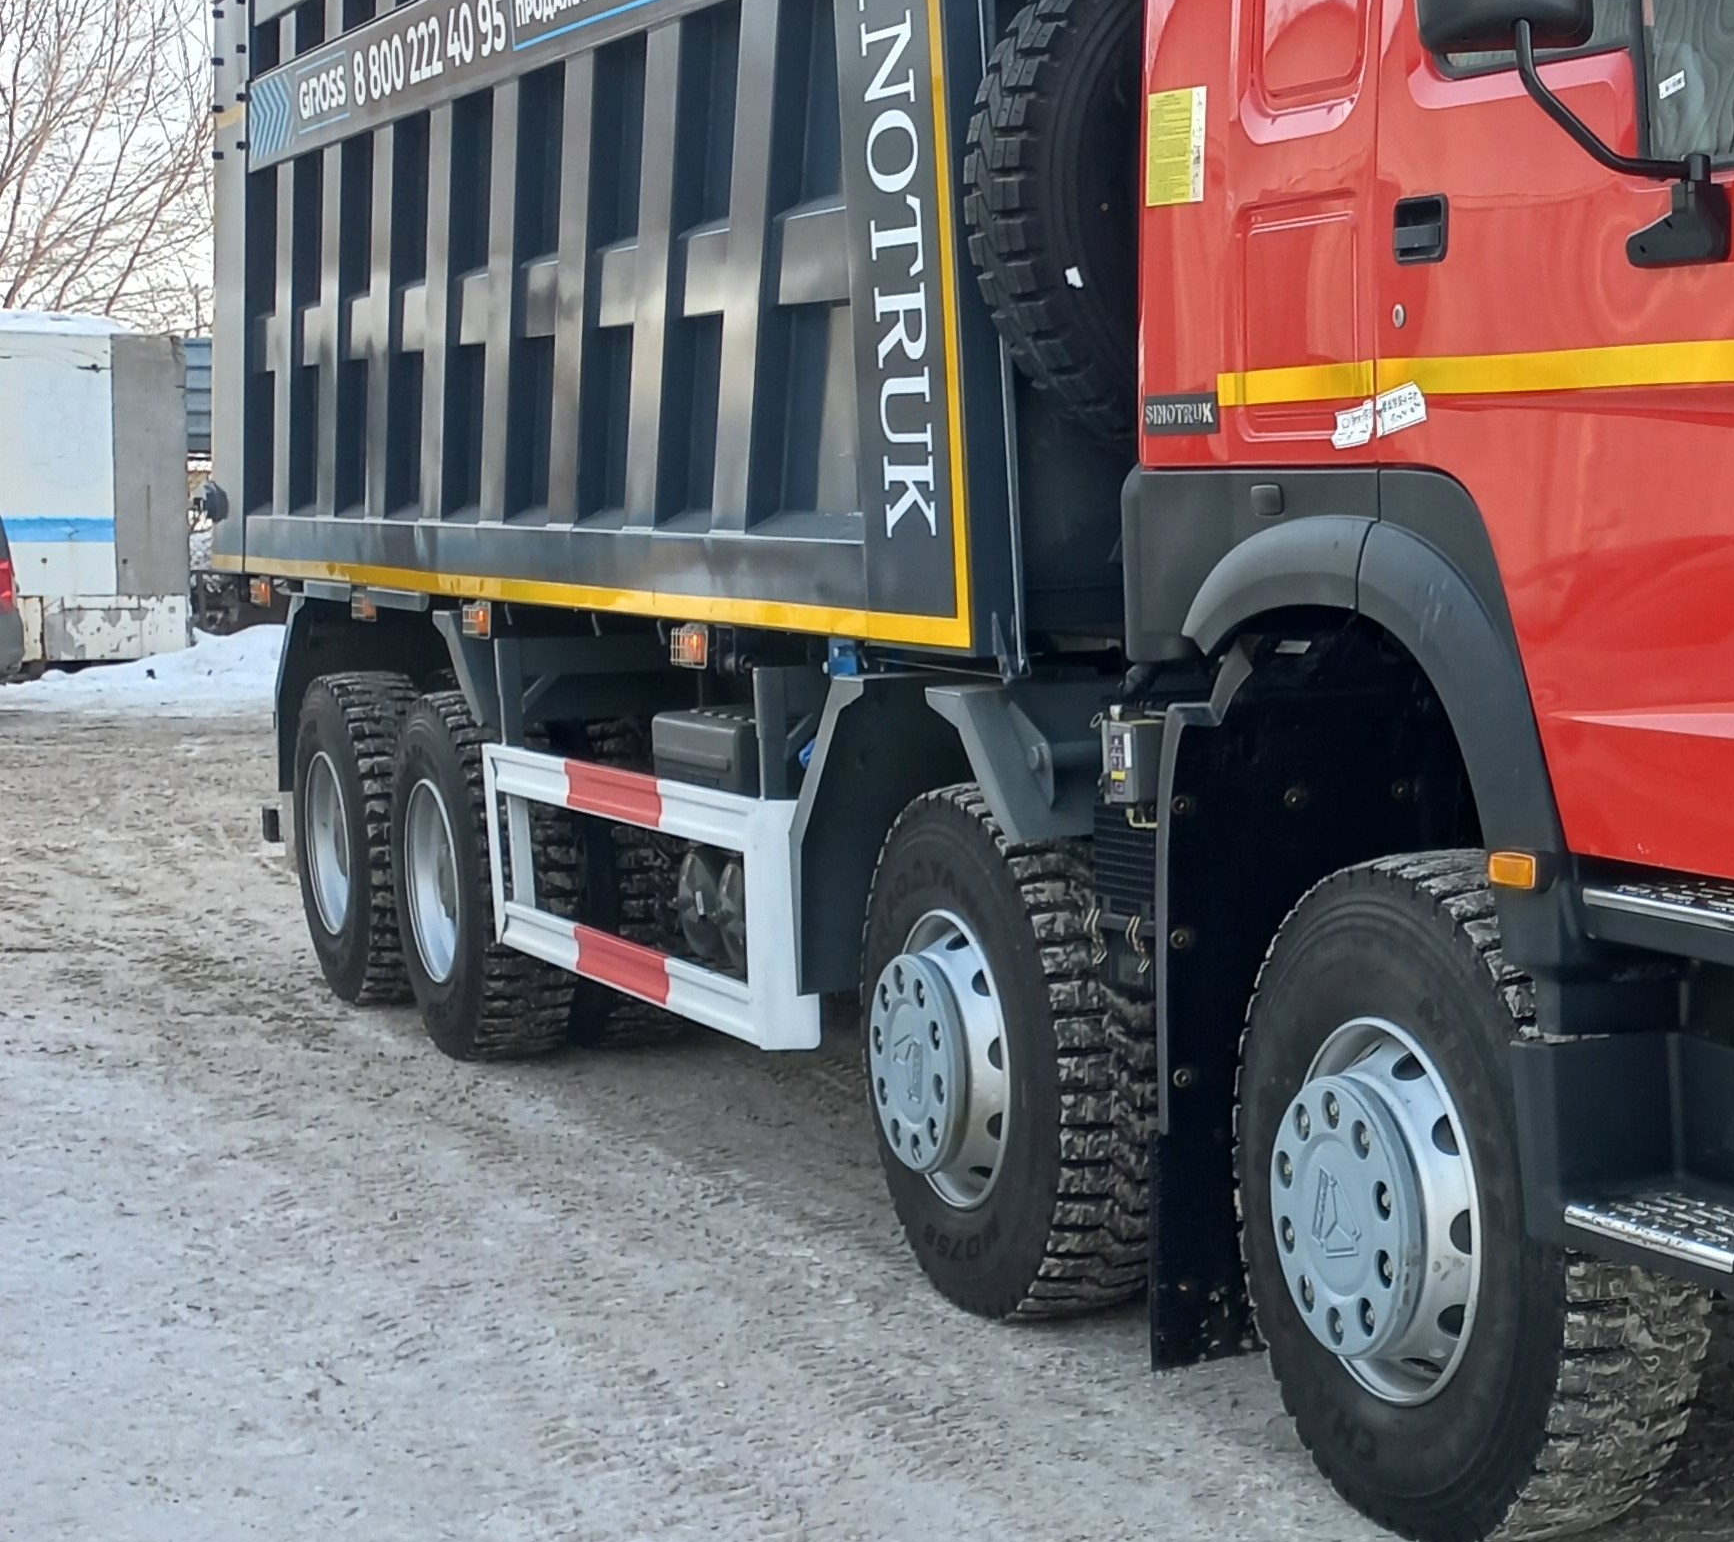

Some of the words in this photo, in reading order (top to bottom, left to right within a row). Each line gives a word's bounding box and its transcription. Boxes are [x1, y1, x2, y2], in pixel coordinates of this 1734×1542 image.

[299, 64, 347, 120] GROSS
[352, 50, 367, 106] 8
[368, 34, 405, 101] 800
[406, 16, 444, 85] 222
[446, 2, 474, 67] 40
[1145, 402, 1214, 425] SINOTRUK
